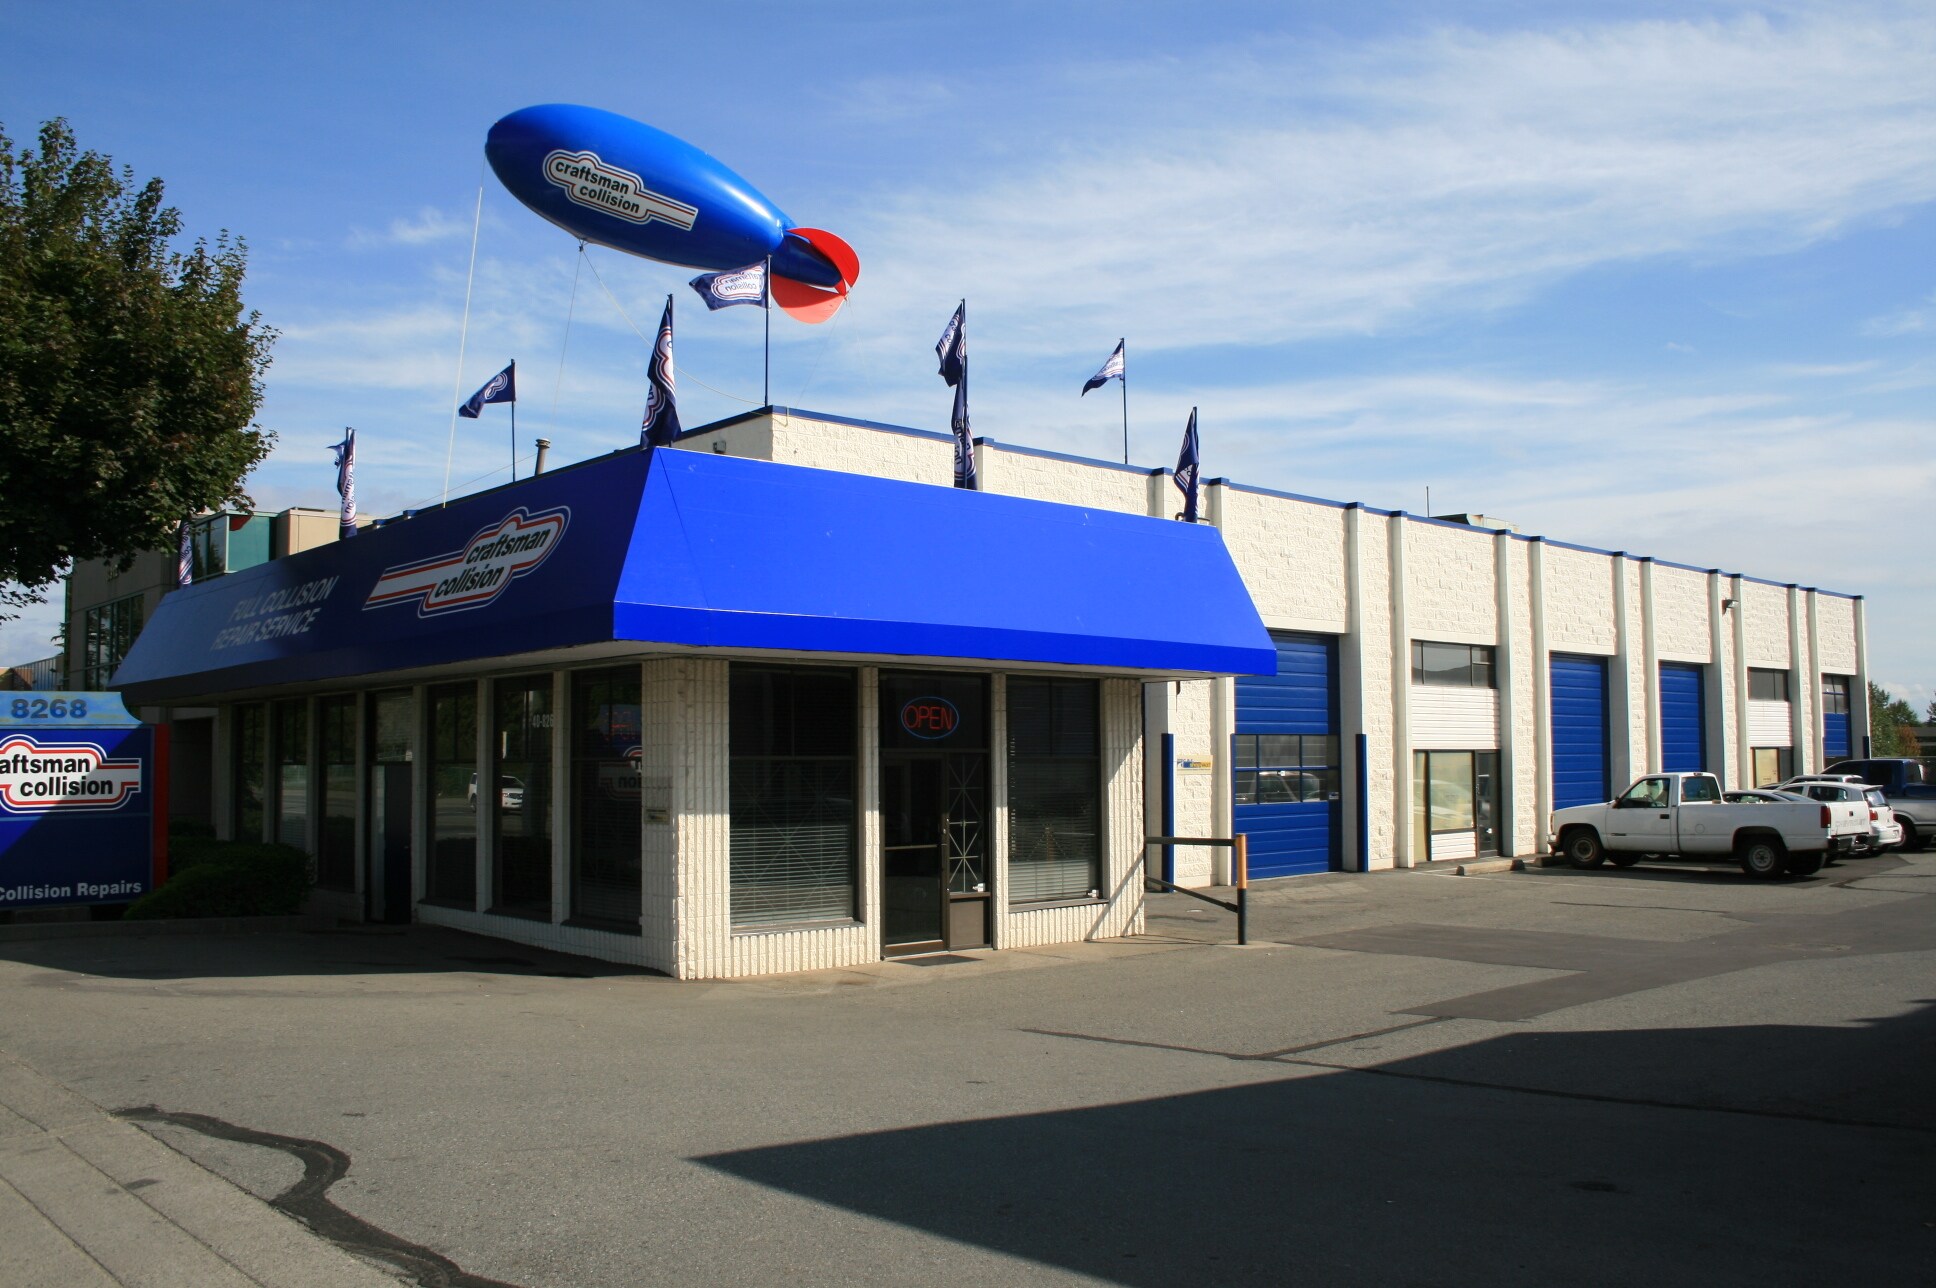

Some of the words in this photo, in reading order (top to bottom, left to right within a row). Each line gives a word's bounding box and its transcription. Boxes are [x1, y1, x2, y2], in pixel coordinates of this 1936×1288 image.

[555, 161, 629, 195] craftsman
[579, 185, 640, 214] collision
[465, 529, 551, 565] craftsman
[434, 563, 505, 598] collision
[228, 595, 263, 623] FULL
[260, 575, 340, 615] COLLISION
[209, 621, 262, 652] REPAIR
[254, 607, 322, 643] SERVICE
[10, 698, 88, 719] 8268
[904, 705, 952, 731] OPEN
[0, 754, 91, 775] aftsman
[20, 776, 114, 796] collision
[77, 880, 142, 898] Repairs
